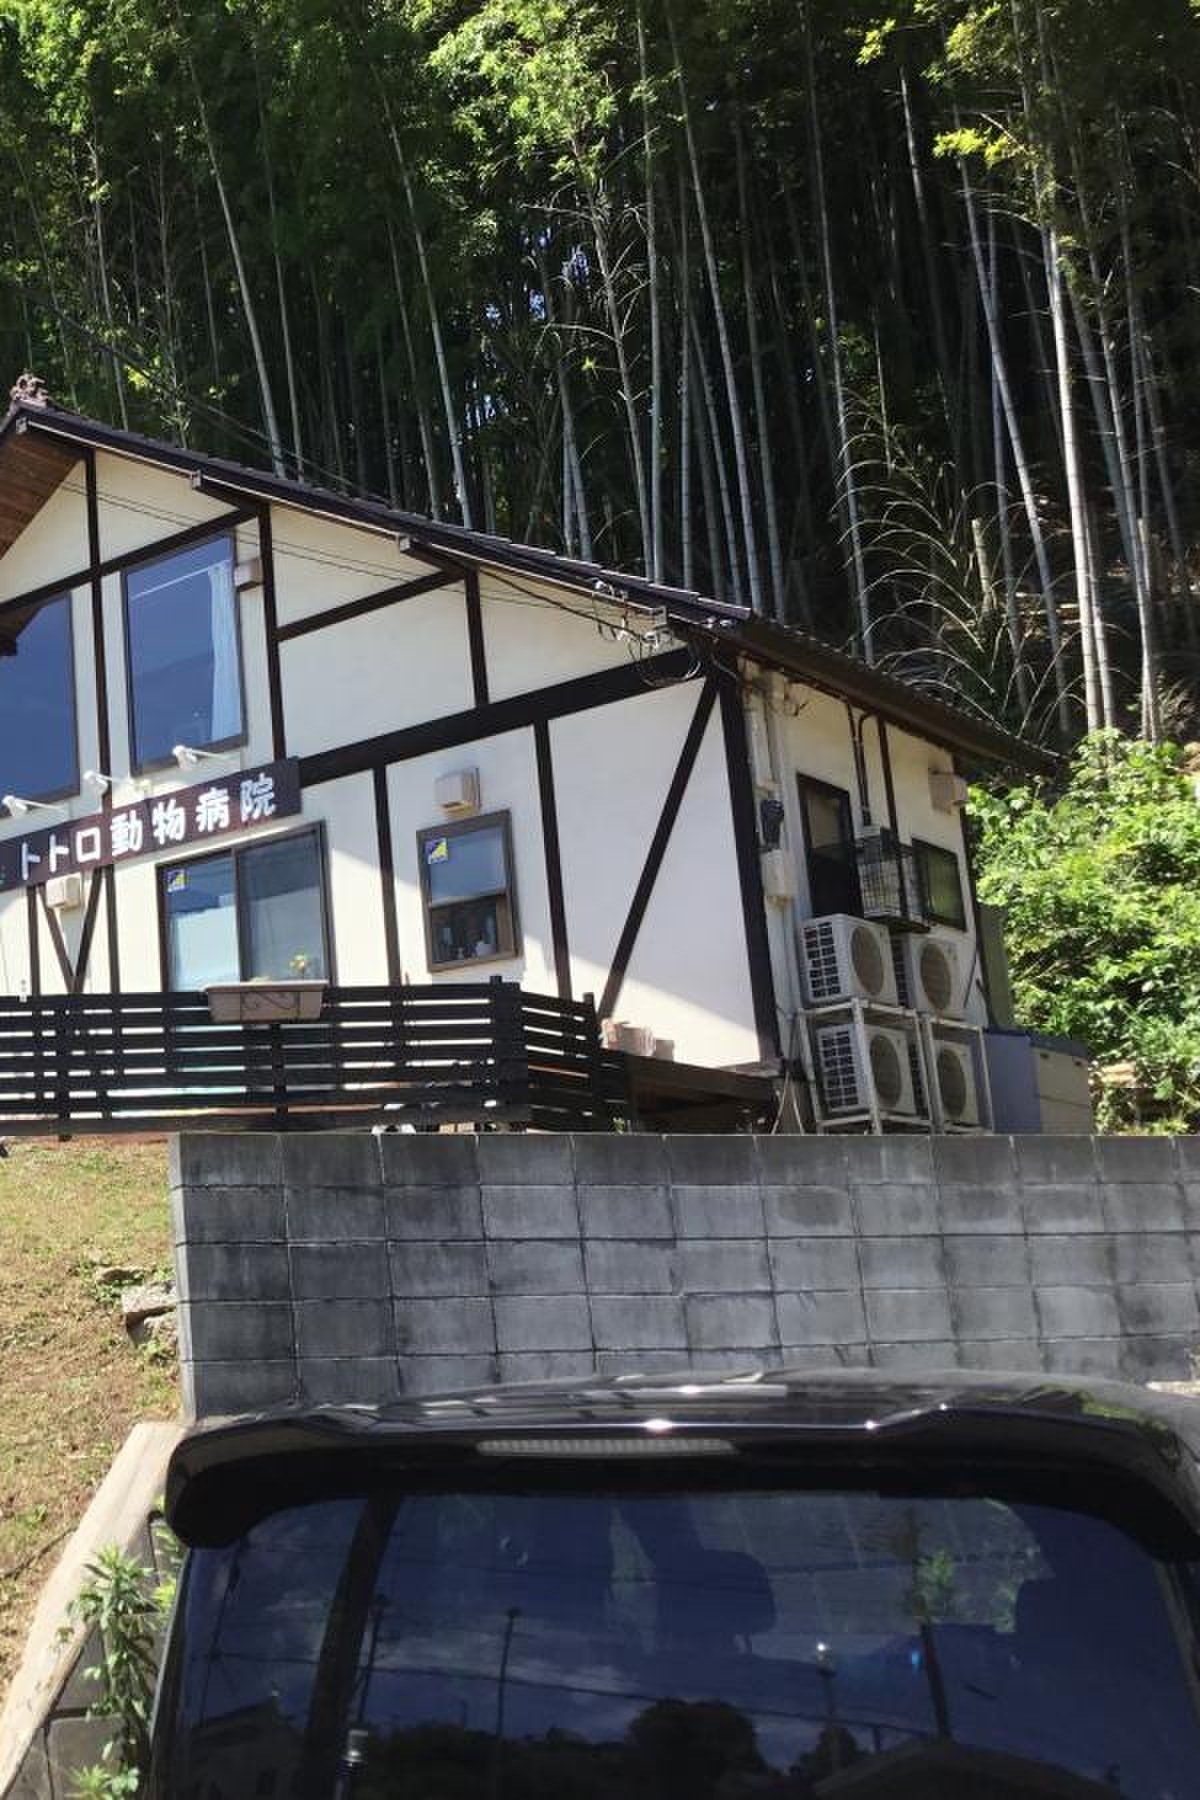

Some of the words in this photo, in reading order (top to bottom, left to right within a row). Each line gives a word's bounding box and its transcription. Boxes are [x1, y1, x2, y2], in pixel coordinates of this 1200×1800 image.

[18, 772, 278, 881] トトロ動物病院
